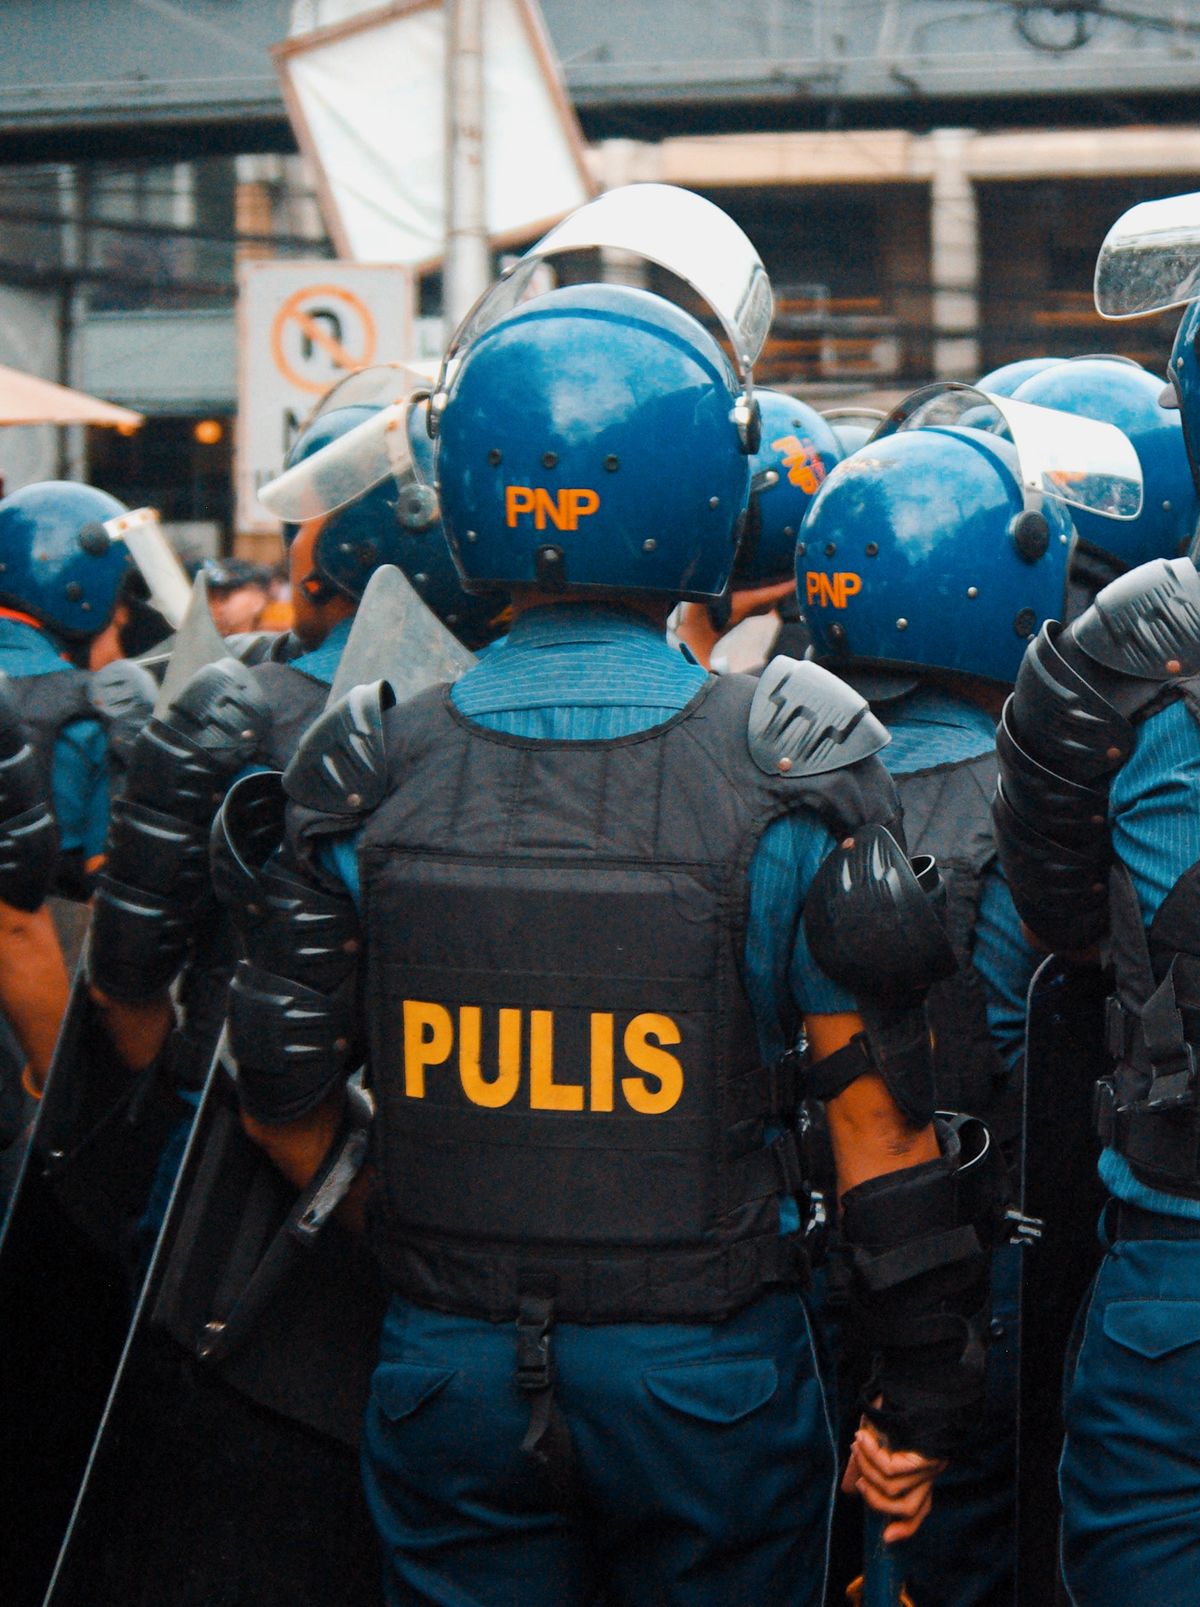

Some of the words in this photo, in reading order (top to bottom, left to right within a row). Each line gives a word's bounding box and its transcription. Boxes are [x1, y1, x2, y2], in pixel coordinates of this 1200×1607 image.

[505, 485, 600, 531] PNP
[806, 571, 862, 609] PNP
[403, 1000, 684, 1115] PULIS
